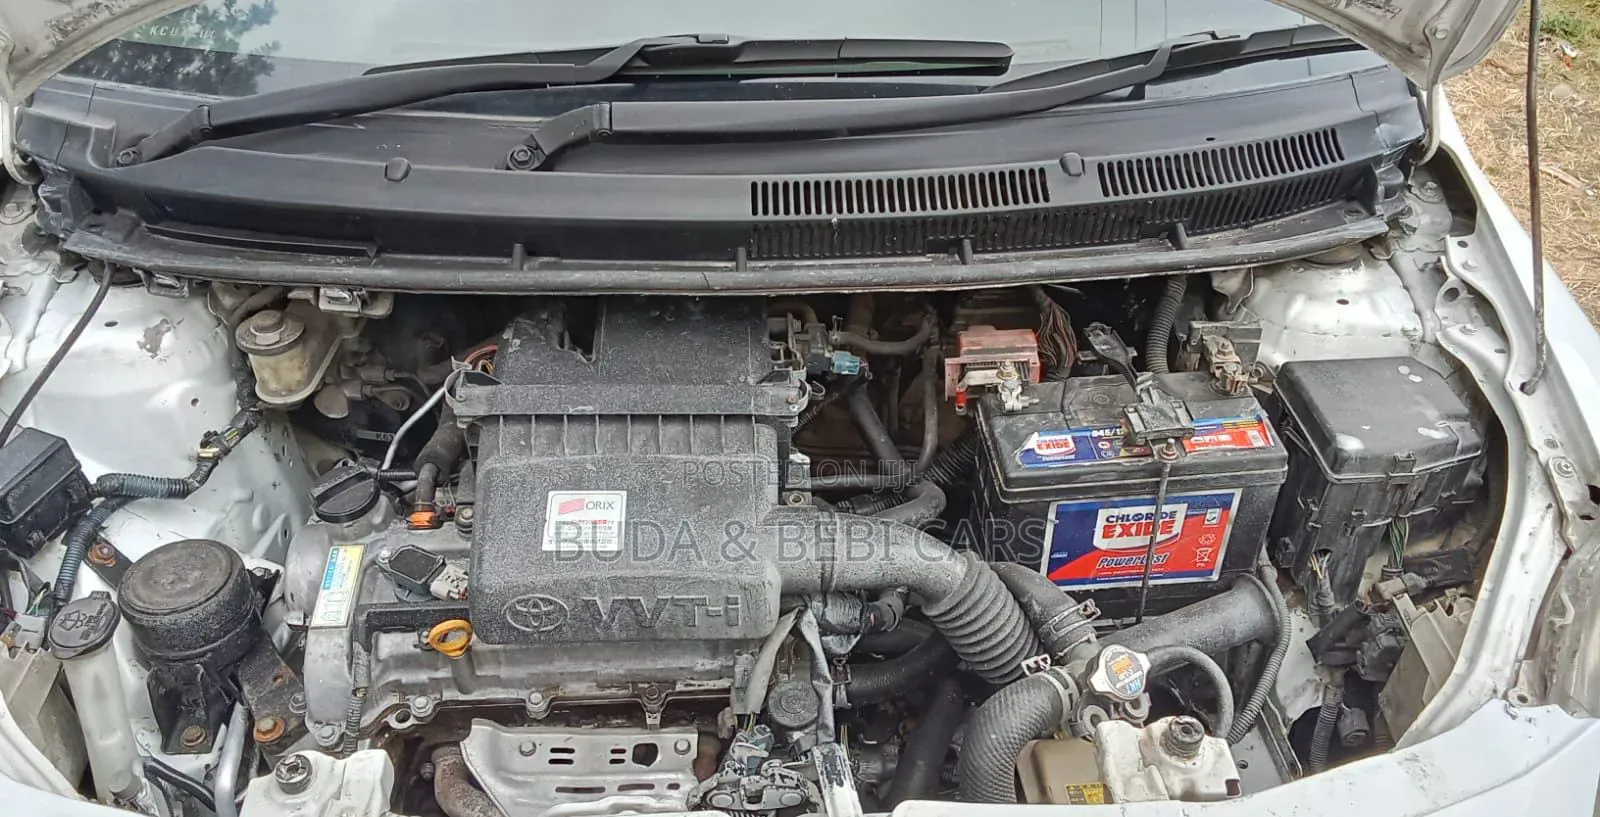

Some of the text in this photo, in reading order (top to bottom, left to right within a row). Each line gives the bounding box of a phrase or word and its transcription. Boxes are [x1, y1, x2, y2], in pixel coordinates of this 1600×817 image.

[1036, 441, 1070, 450] EXIDE
[585, 500, 615, 511] ORIX
[1105, 510, 1178, 524] CHLORDE
[1097, 553, 1169, 568] PowerLst
